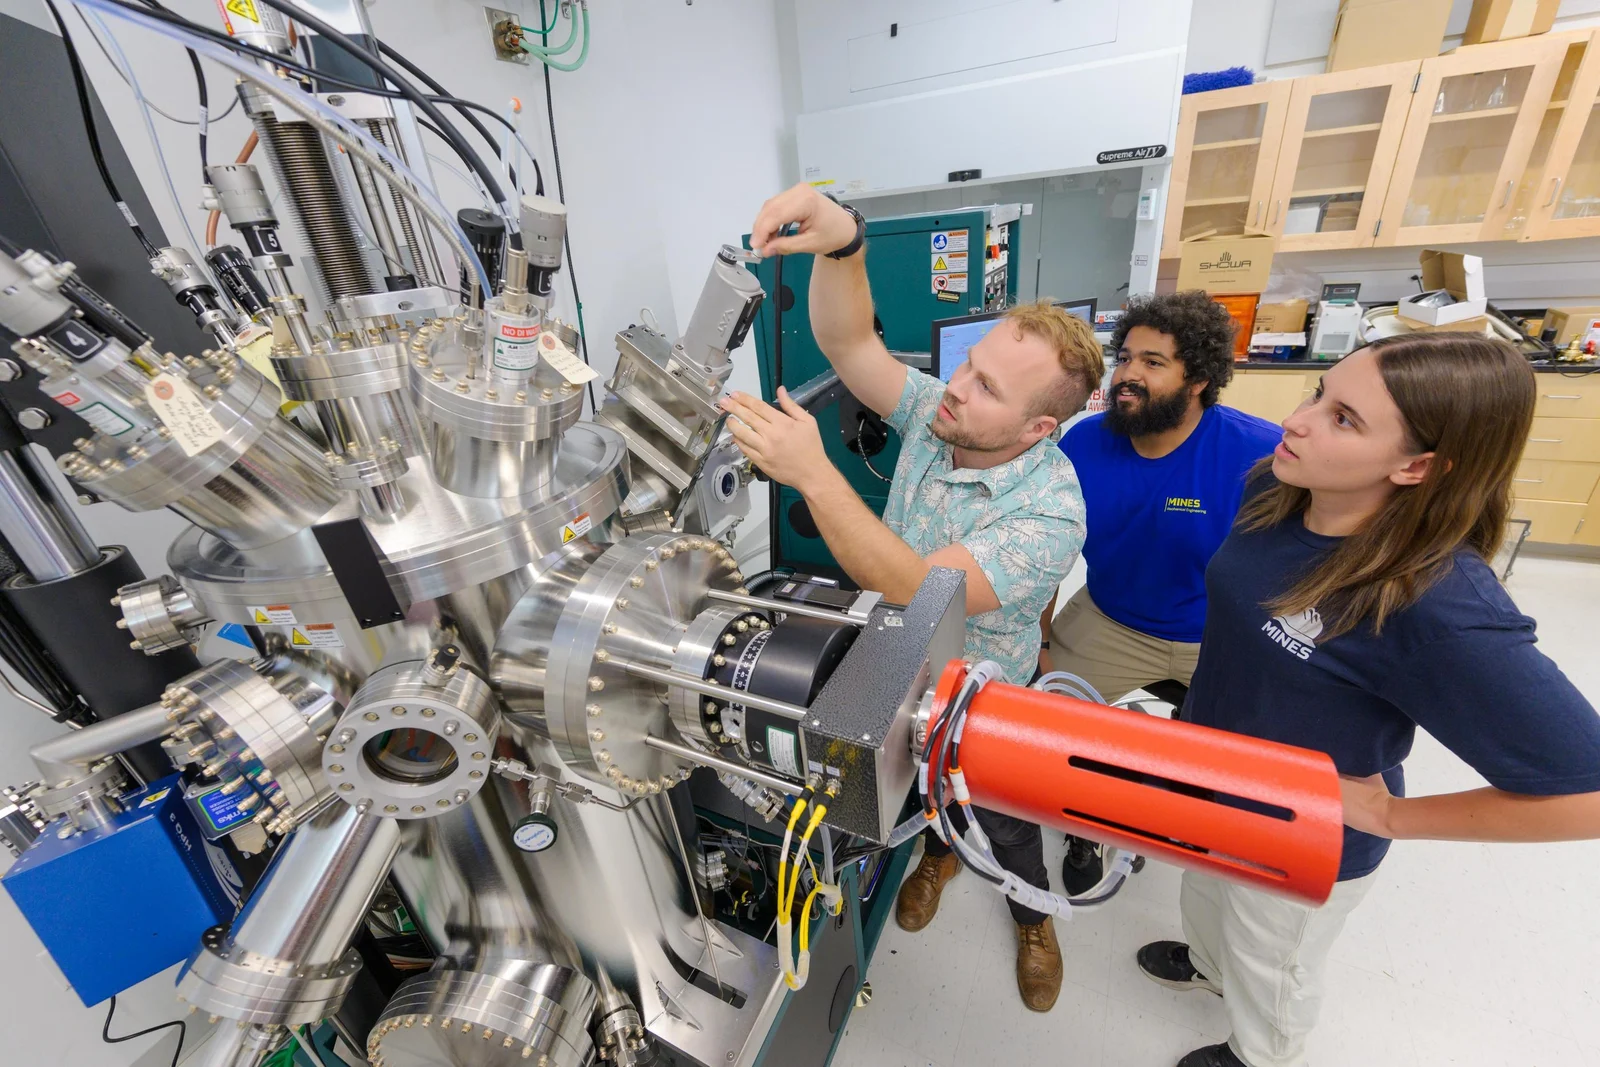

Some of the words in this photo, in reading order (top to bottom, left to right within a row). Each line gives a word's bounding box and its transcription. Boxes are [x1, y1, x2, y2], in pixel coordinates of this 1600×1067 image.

[1100, 151, 1133, 161] Supreme
[1135, 148, 1146, 157] Air
[267, 233, 278, 248] 5
[1199, 260, 1252, 270] SHOWA
[65, 330, 88, 347] 4
[503, 327, 516, 336] NO
[516, 329, 524, 337] DI
[1168, 497, 1201, 508] MINES
[1261, 620, 1313, 660] MINES
[217, 811, 241, 824] mks
[175, 822, 193, 852] HPQ
